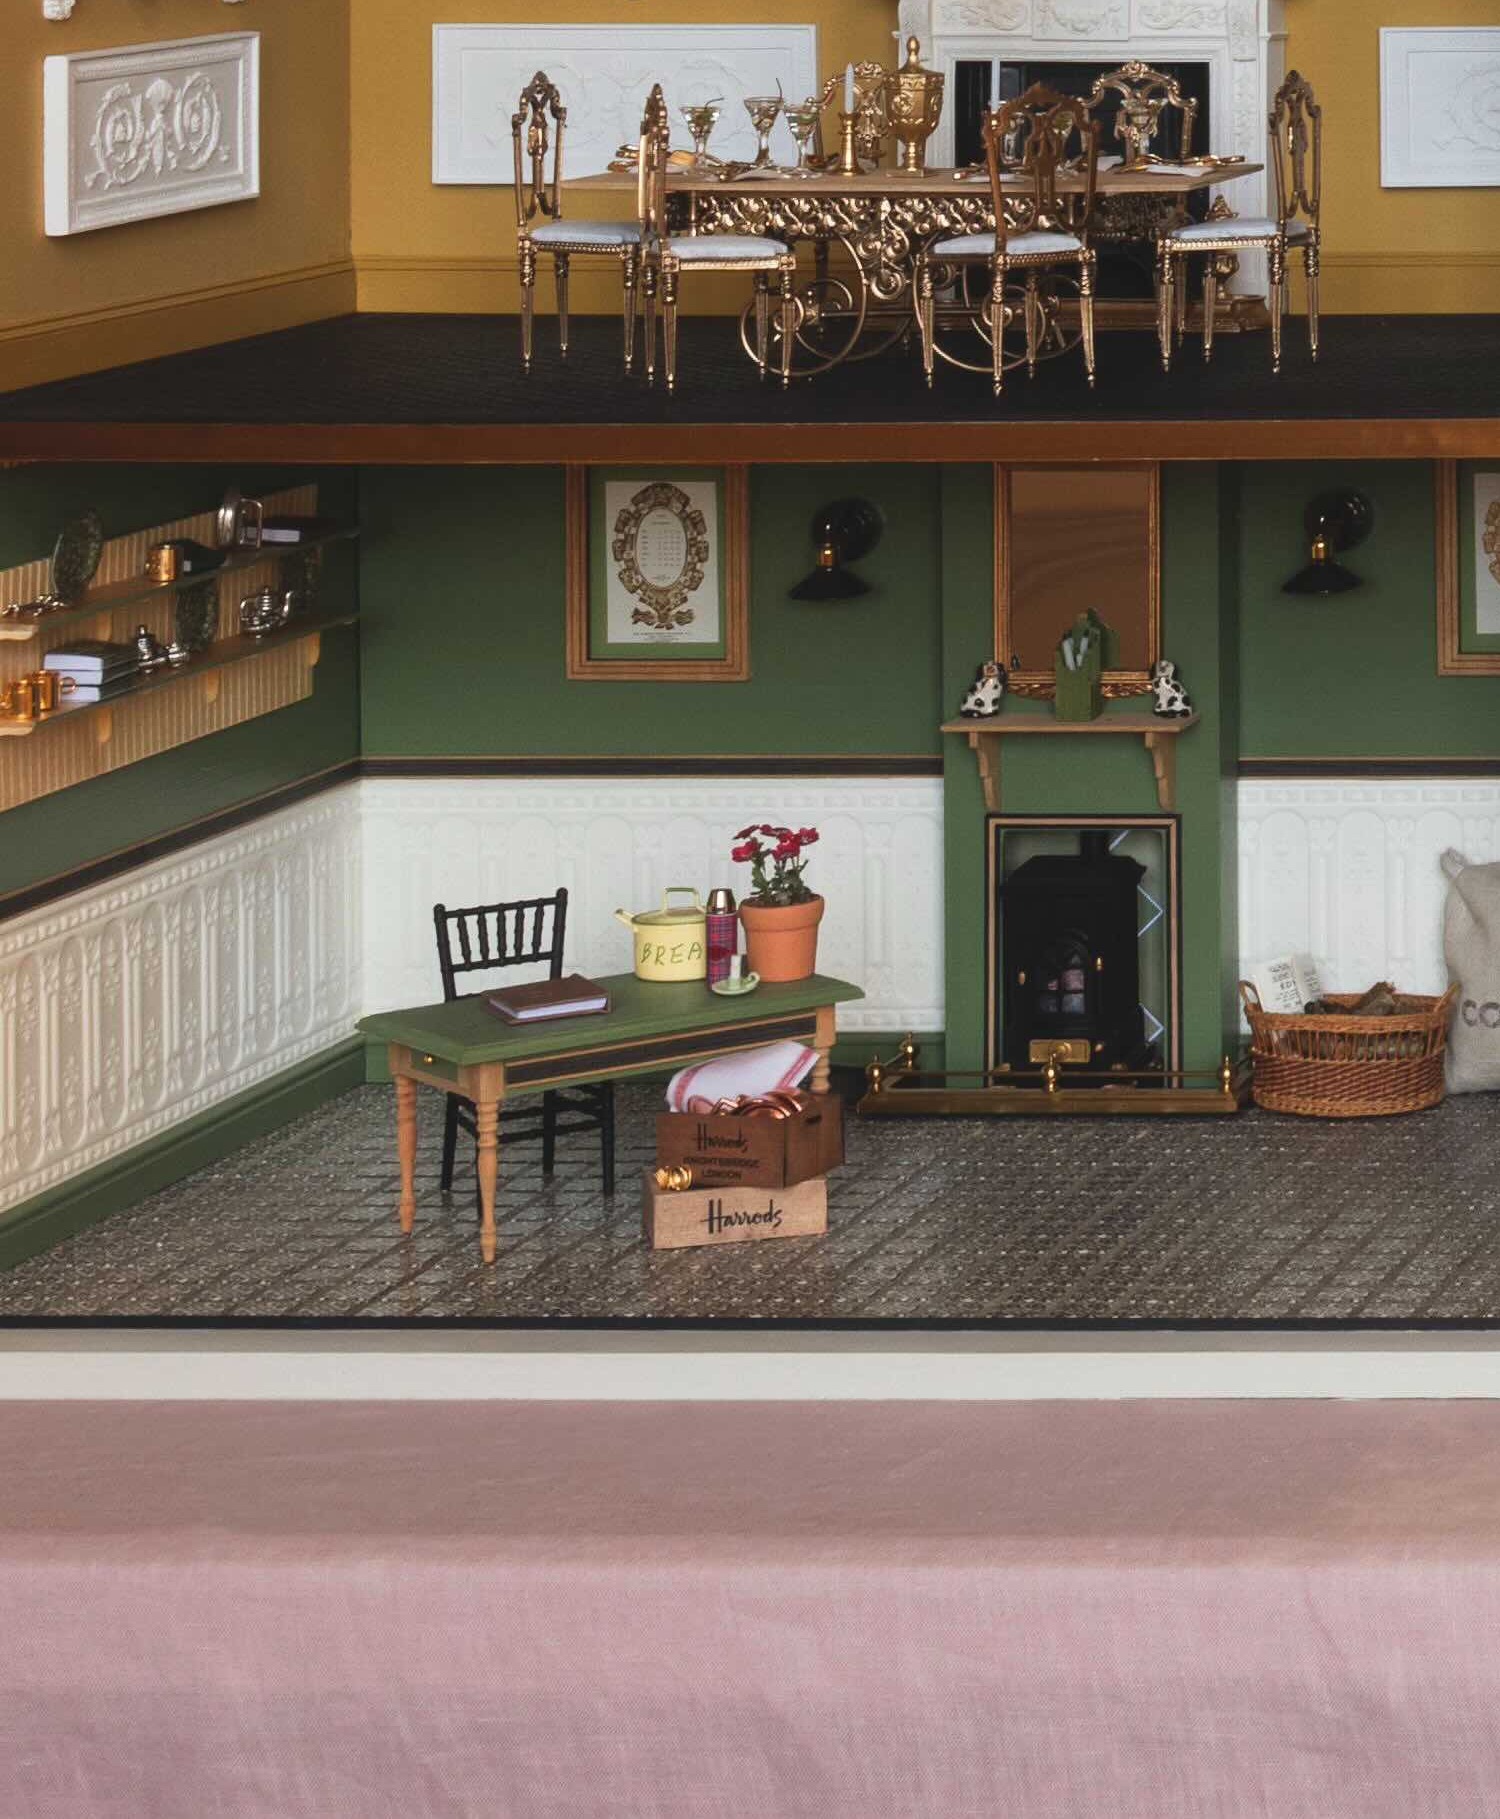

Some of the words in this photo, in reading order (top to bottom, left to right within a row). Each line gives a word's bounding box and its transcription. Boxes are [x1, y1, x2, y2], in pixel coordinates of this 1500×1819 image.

[640, 942, 703, 966] BREA
[693, 1122, 748, 1153] Harrods
[700, 1198, 783, 1234] Harrods
